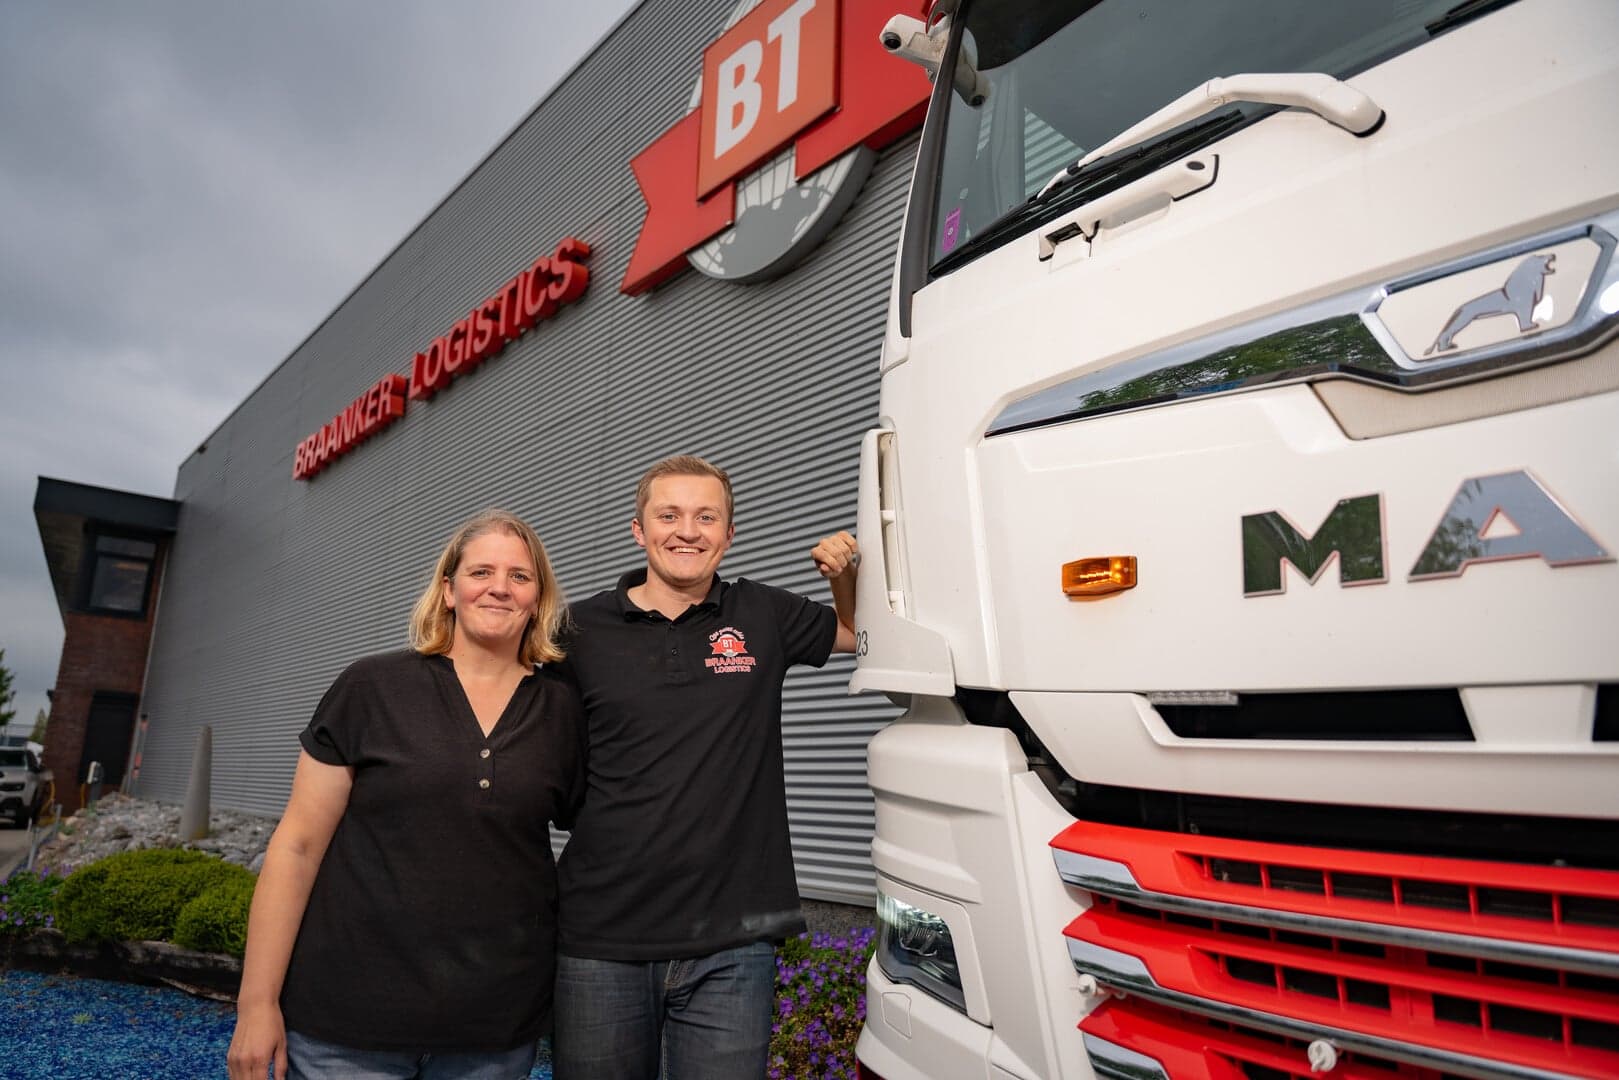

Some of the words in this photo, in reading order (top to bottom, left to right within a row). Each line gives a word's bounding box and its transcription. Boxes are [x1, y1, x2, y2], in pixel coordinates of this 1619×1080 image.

[714, 0, 816, 160] BT
[292, 373, 406, 480] BRAANKER
[407, 236, 591, 400] LOGISTICS
[722, 639, 734, 649] BT
[704, 656, 756, 668] BRAANKER
[714, 665, 751, 674] LOGISTICS
